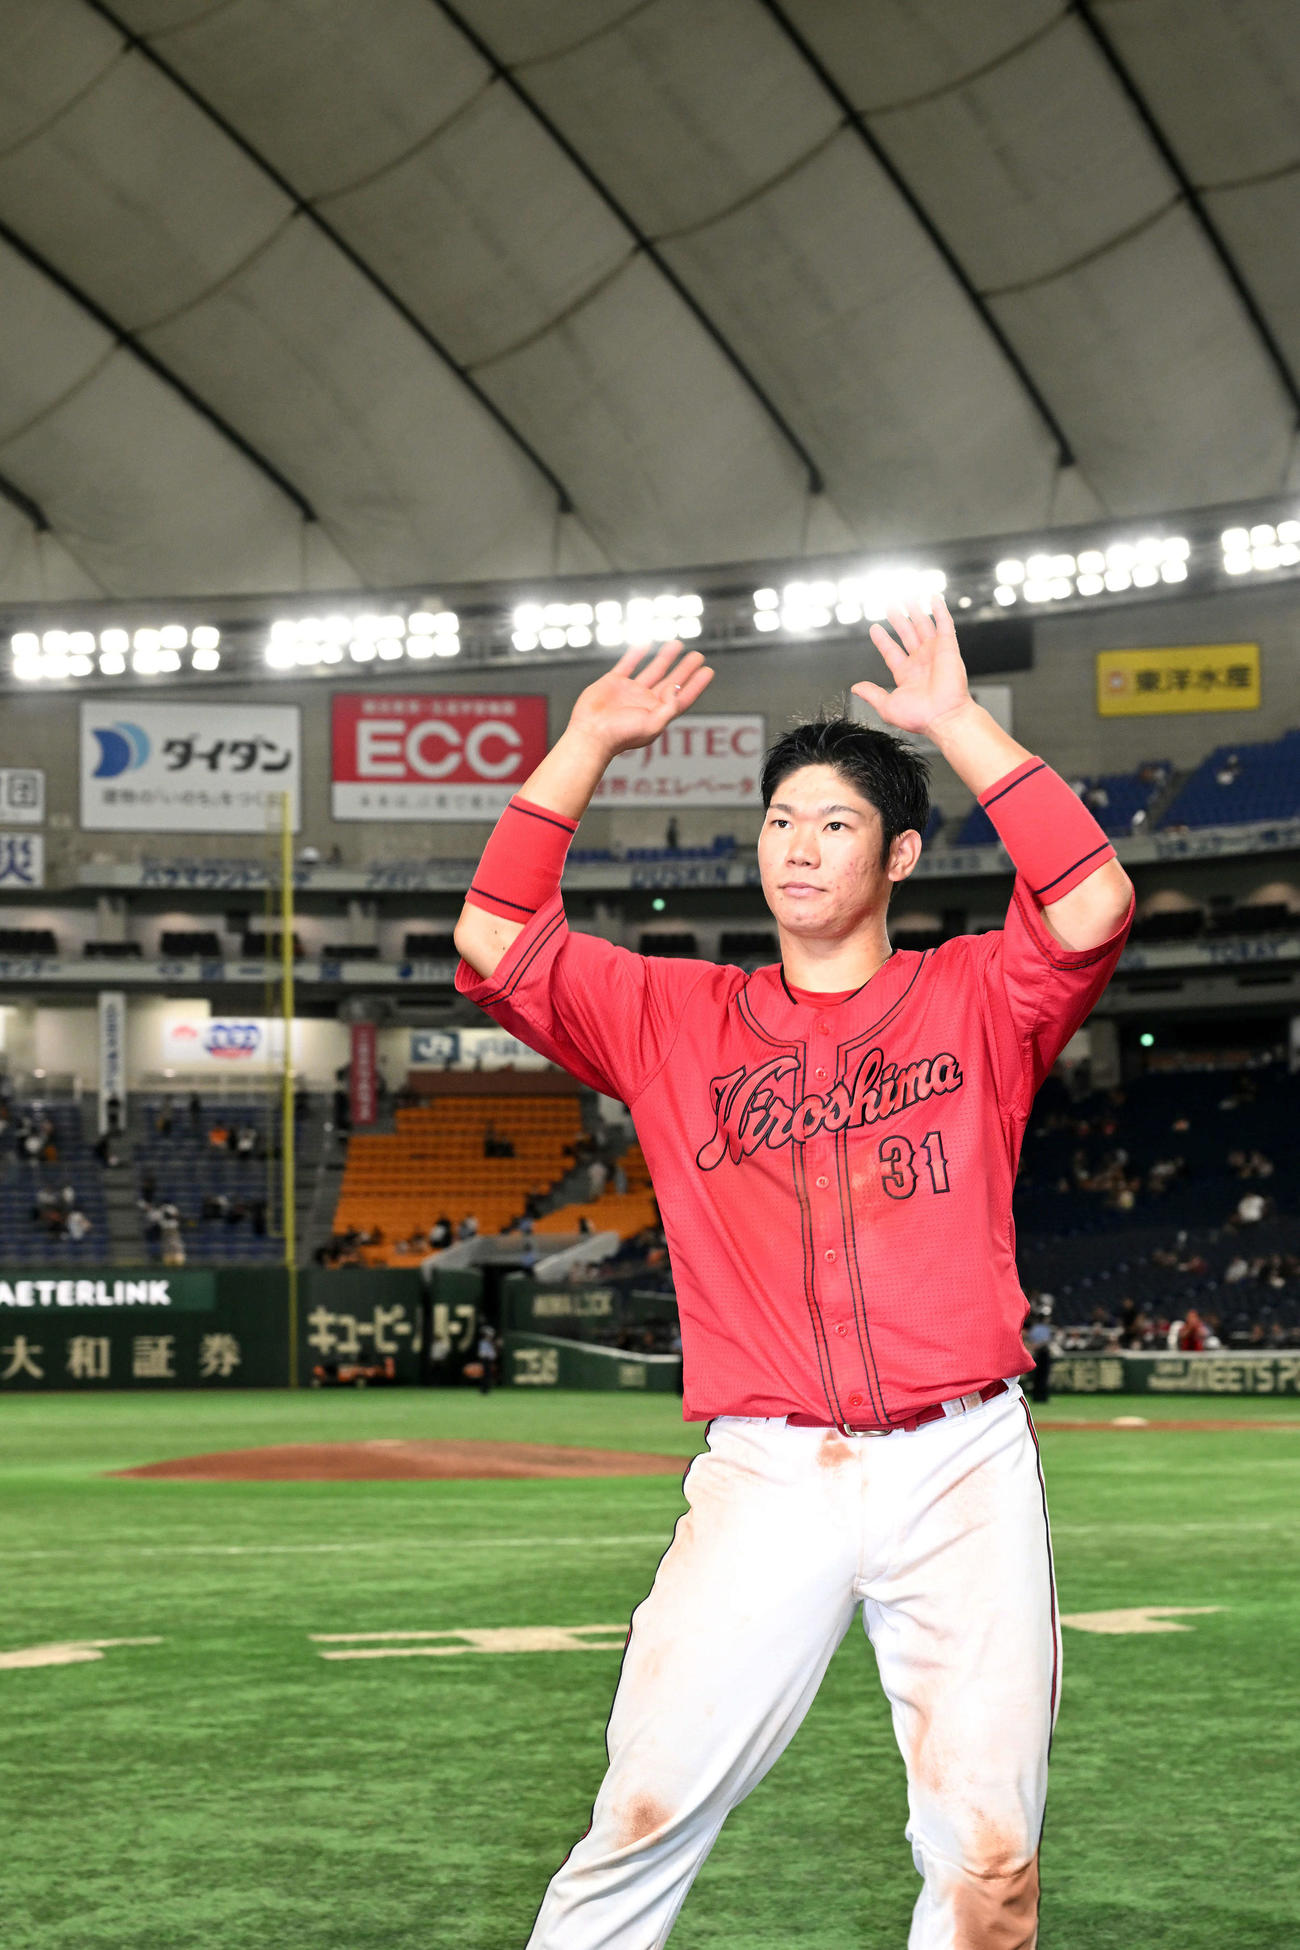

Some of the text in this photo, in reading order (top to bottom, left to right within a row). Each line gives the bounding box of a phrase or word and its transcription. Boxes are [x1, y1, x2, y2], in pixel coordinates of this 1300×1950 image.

[1136, 665, 1252, 693] 東洋水産
[162, 732, 292, 772] ダイダン
[356, 719, 523, 778] ECC
[616, 725, 760, 768] JITEC
[696, 1048, 963, 1171] Hiroshima
[879, 1131, 950, 1200] 31
[0, 1280, 171, 1306] AETERLINK
[2, 1333, 241, 1379] 大和証券
